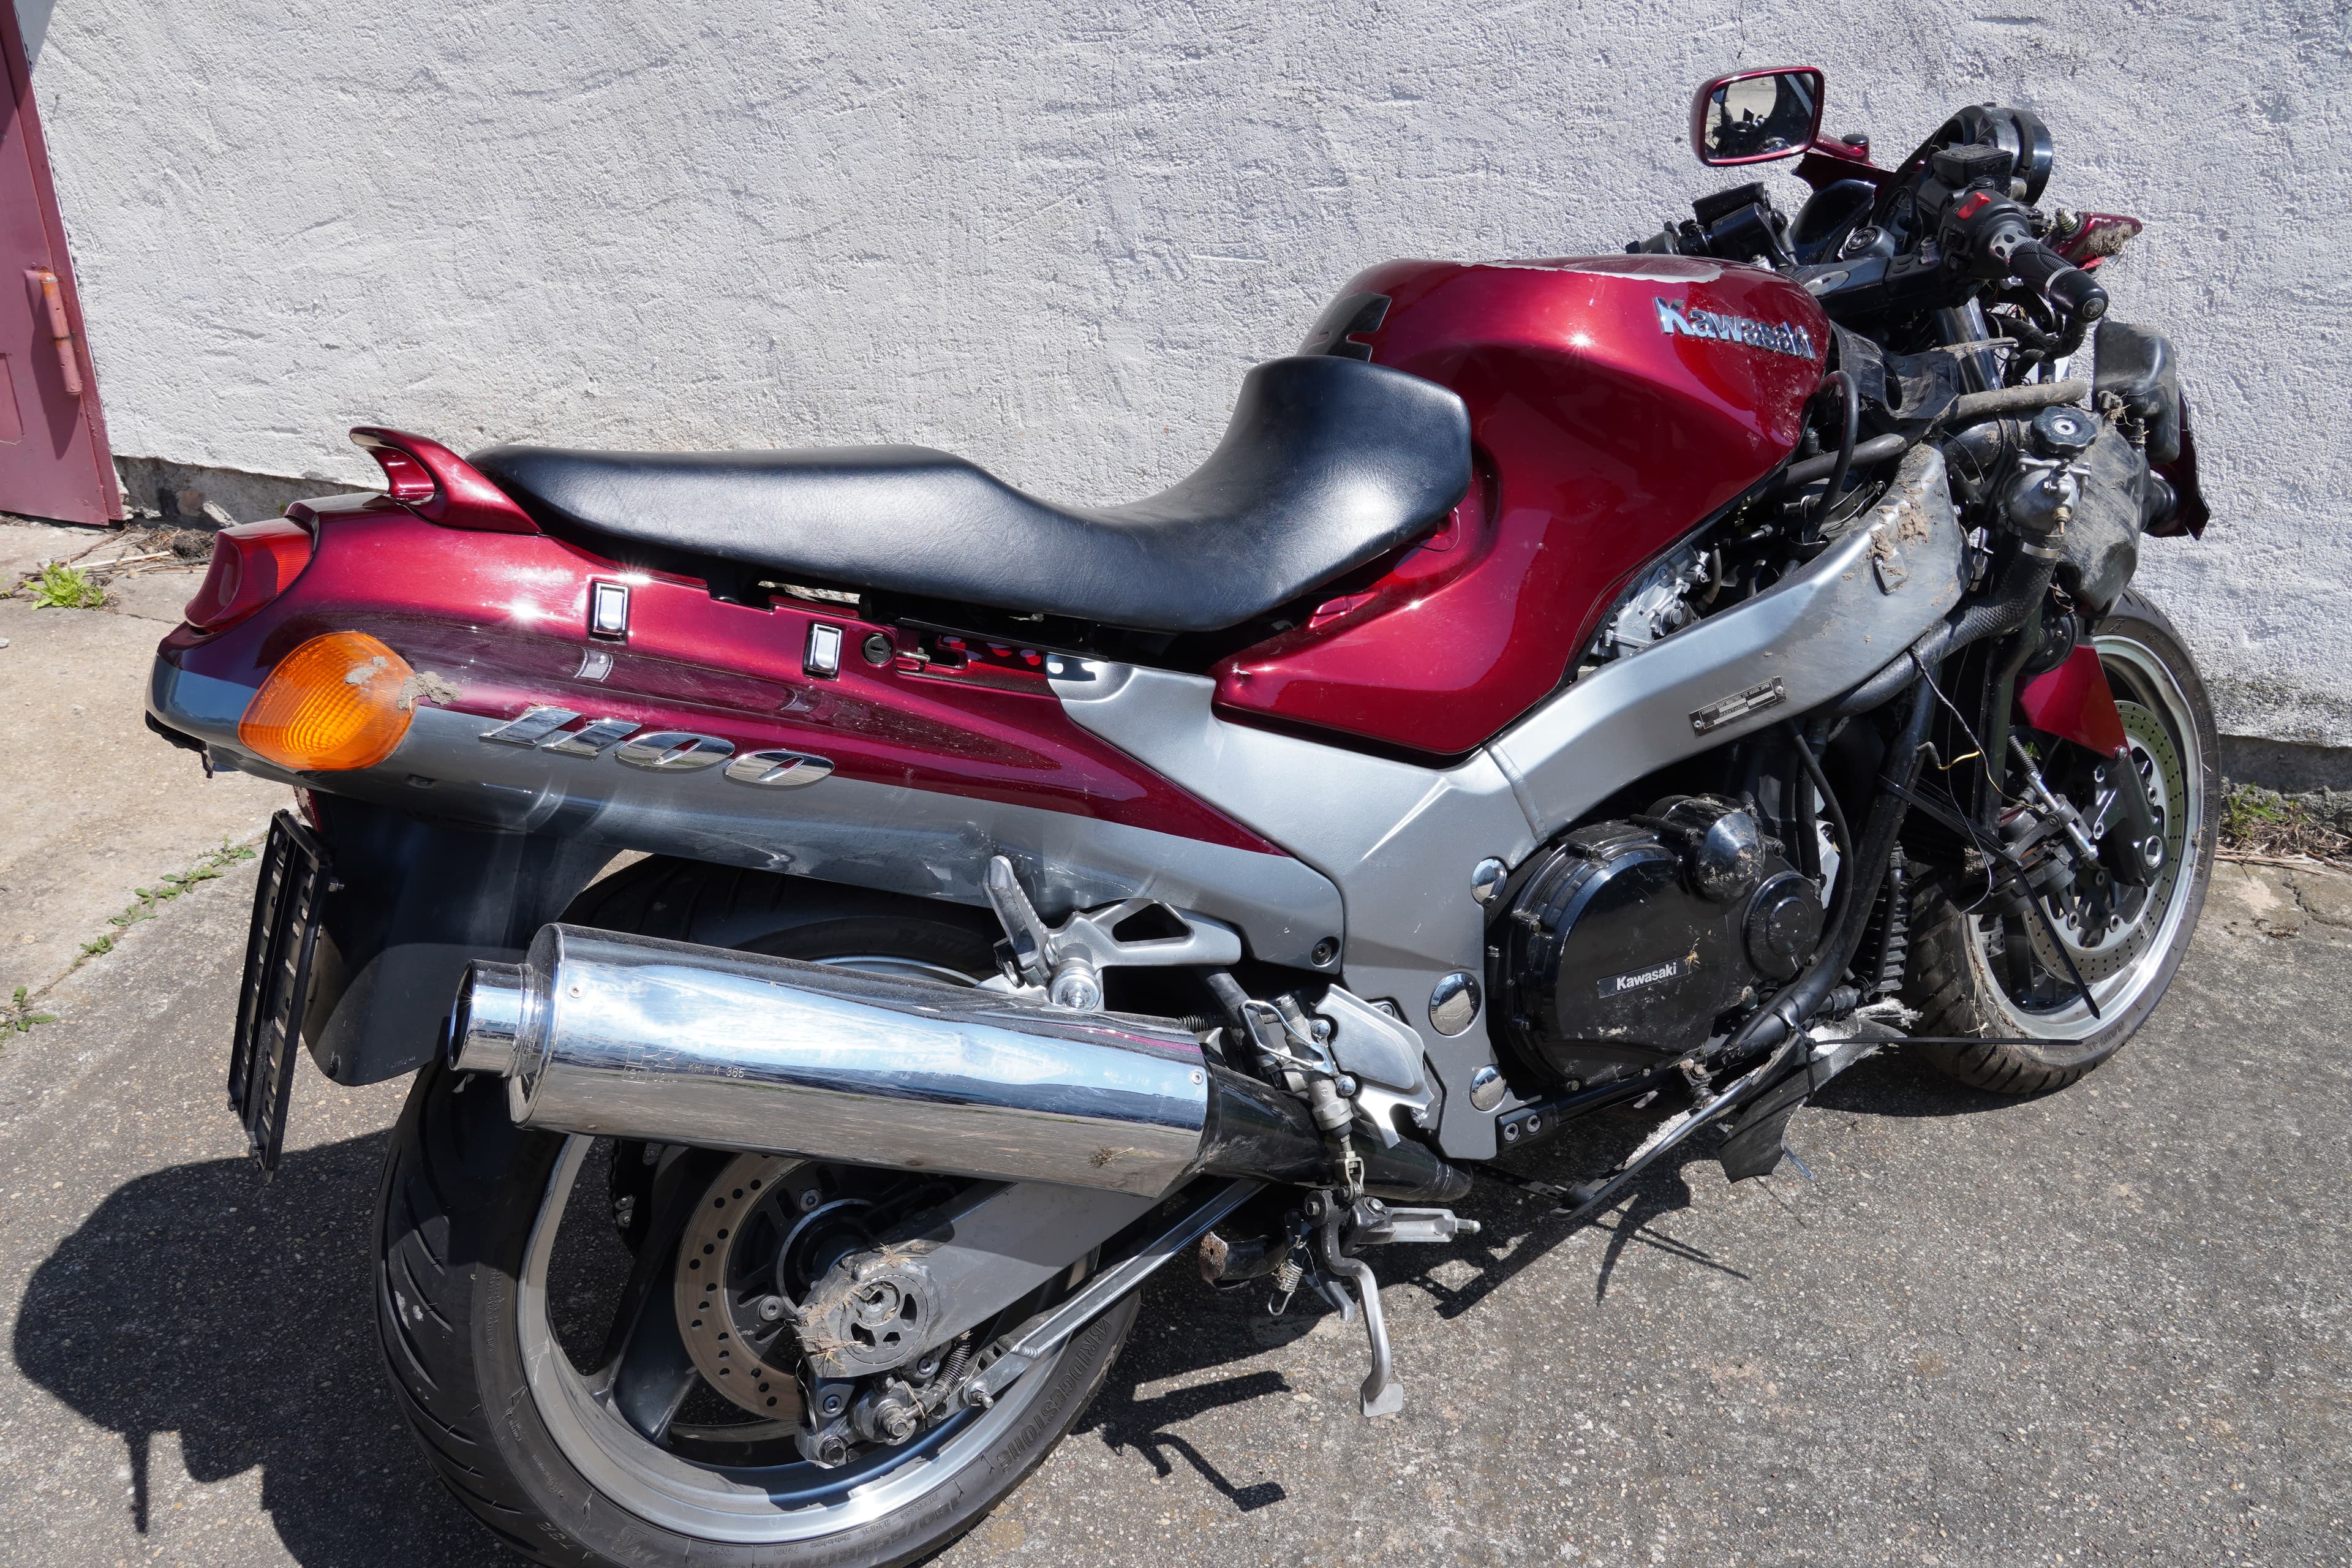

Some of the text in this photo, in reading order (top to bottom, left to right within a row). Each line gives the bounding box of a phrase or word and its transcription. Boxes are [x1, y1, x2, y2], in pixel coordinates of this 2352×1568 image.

[1654, 297, 1816, 360] Kawasaki
[478, 705, 835, 788] 1100
[1616, 962, 1677, 991] Kawasaki
[712, 1063, 720, 1075] K
[726, 1066, 746, 1079] 365
[900, 1493, 941, 1520] TUBELESS
[861, 1519, 892, 1536] RADIAL
